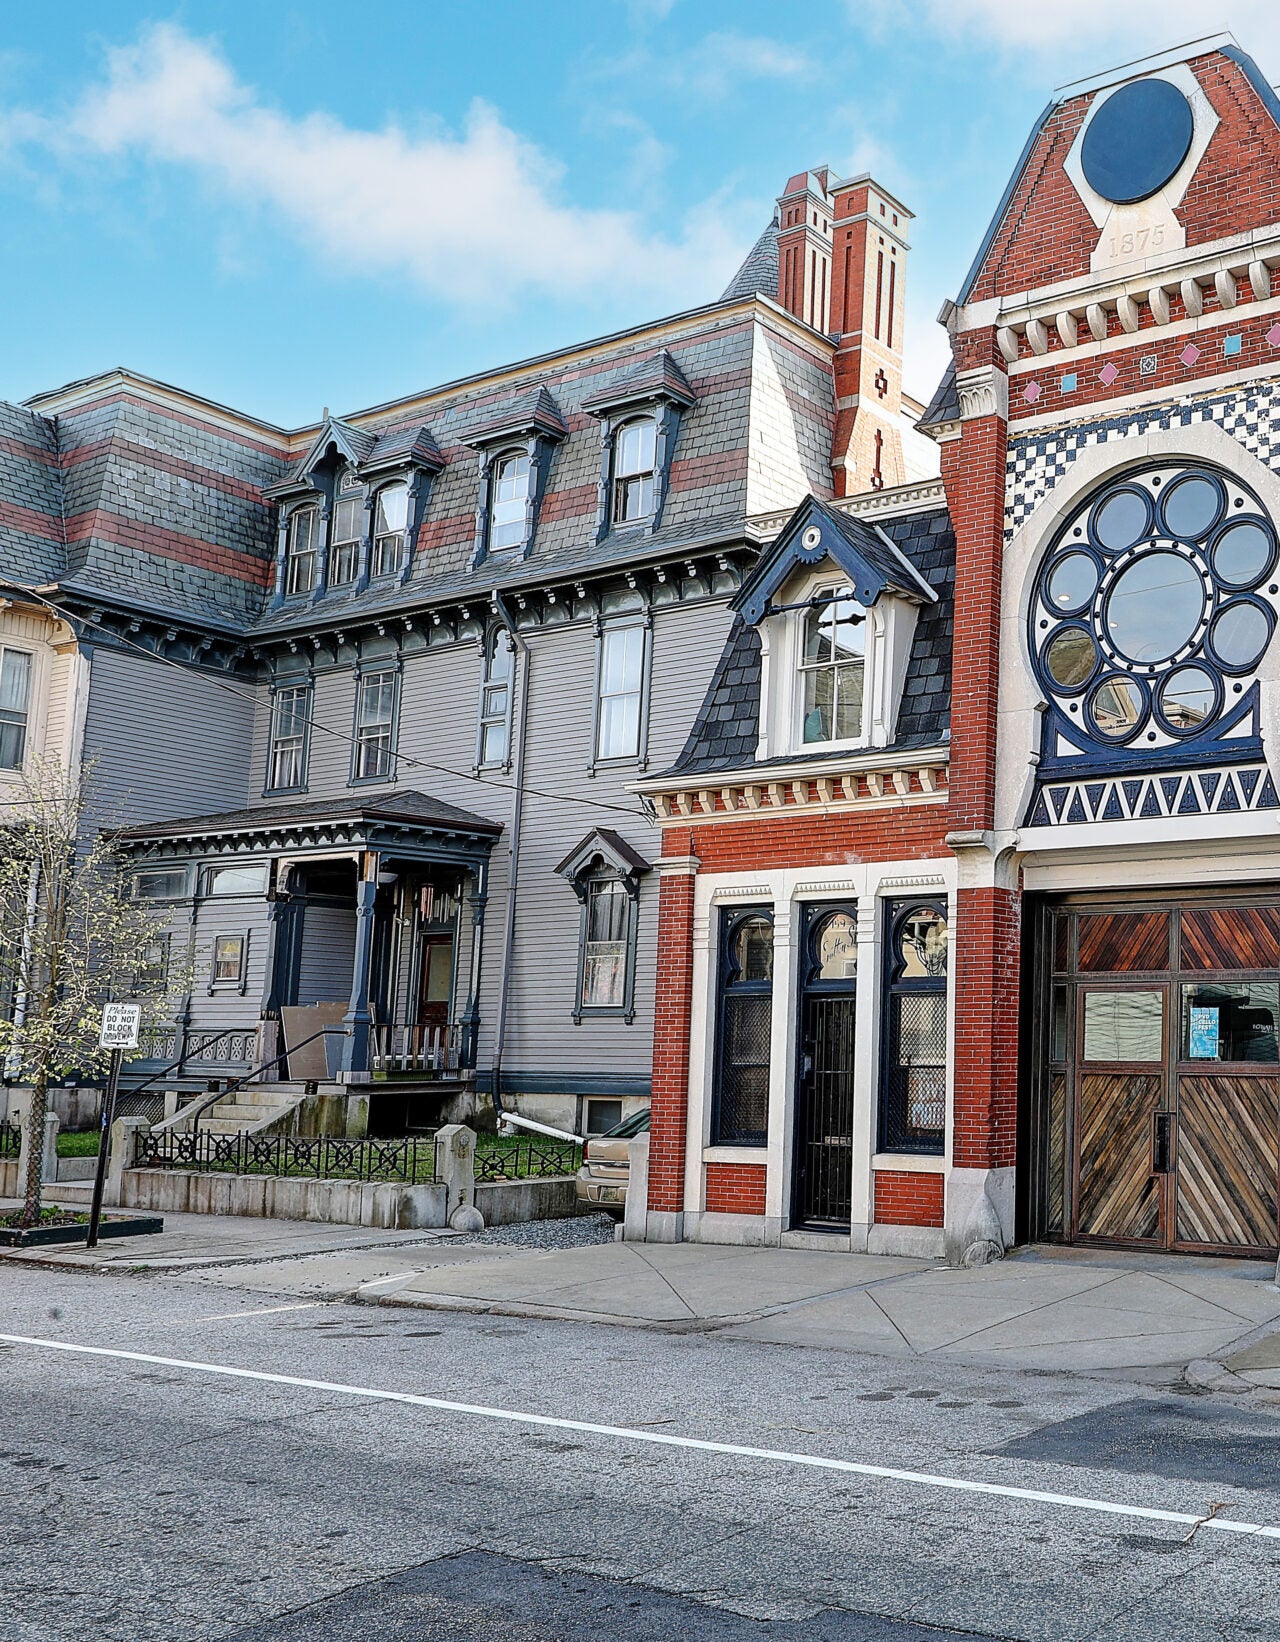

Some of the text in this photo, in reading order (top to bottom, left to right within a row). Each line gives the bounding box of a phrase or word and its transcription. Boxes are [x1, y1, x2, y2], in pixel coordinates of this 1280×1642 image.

[1109, 224, 1165, 258] 1875
[108, 1006, 137, 1015] Please
[107, 1024, 133, 1032] BLOCK
[104, 1032, 134, 1041] DRIVEWAY
